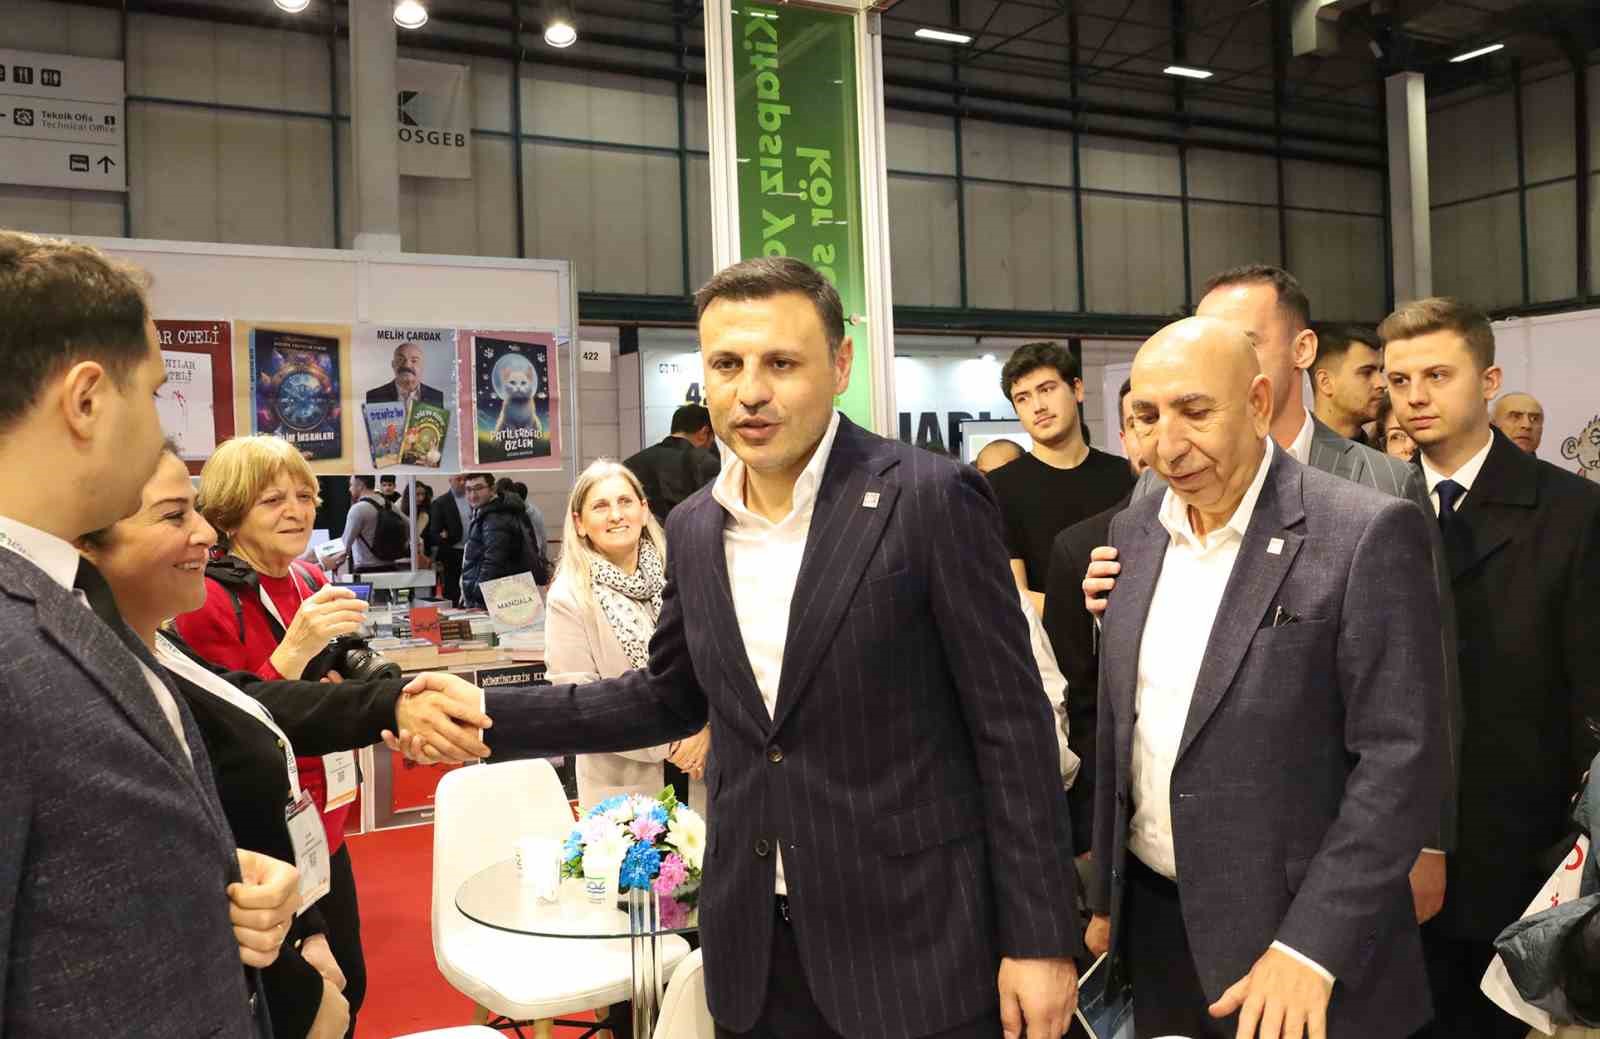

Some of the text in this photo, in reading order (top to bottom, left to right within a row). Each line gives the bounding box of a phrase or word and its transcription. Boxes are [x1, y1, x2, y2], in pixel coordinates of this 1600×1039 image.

[41, 111, 73, 121] Teknik
[177, 325, 220, 345] OTELİ
[376, 329, 441, 342] MELİH ÇARDAK
[583, 352, 599, 361] 422
[497, 596, 533, 609] MANDALA
